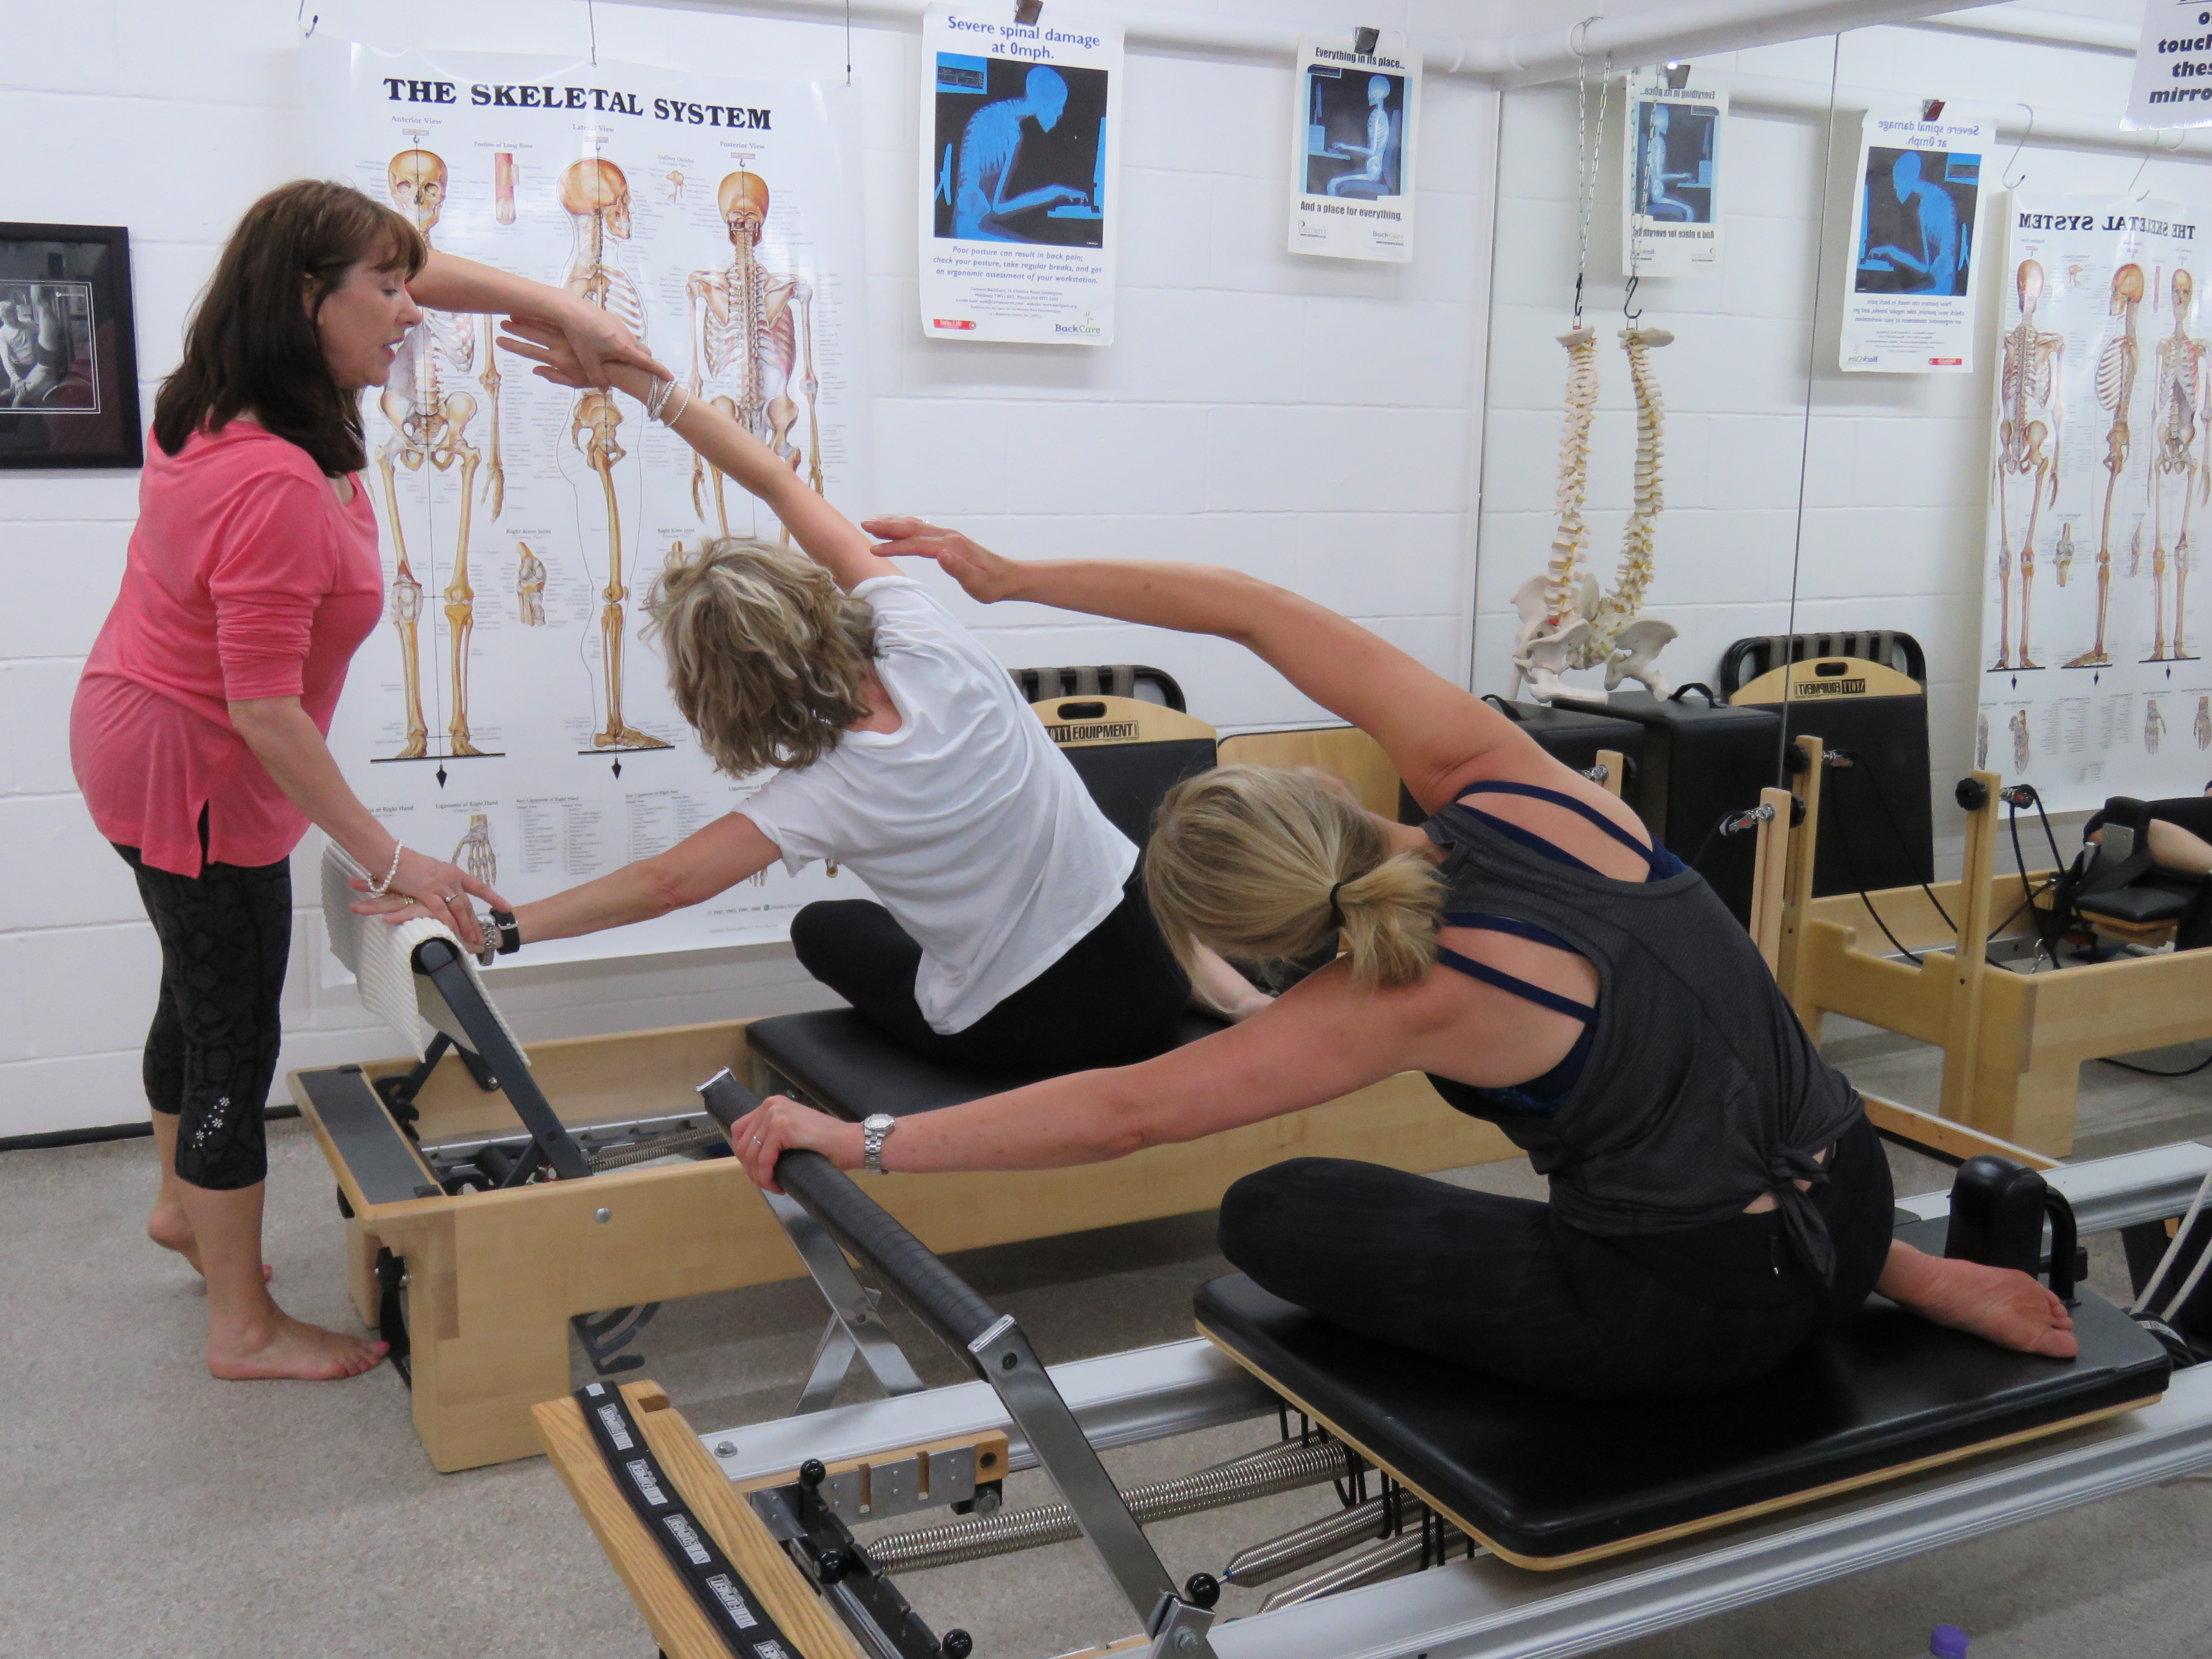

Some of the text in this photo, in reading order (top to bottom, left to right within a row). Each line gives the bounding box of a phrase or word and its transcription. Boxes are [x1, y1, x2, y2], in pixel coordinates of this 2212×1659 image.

[948, 16, 1100, 49] Severe spinal damage
[992, 42, 1054, 61] at 0mph.
[1315, 47, 1356, 63] Everything
[1358, 54, 1365, 63] in
[1367, 55, 1377, 65] its
[383, 78, 772, 130] THE SKELETAL SYSTEM
[391, 116, 422, 124] Anterior
[573, 123, 596, 132] Lateral
[720, 141, 747, 149] Posterior
[1300, 201, 1315, 212] And
[1323, 204, 1345, 215] place
[1346, 205, 1358, 216] for
[1359, 208, 1403, 222] everything.
[1372, 230, 1405, 239] BackCare
[952, 246, 969, 254] Poor
[971, 247, 998, 258] posture
[1015, 250, 1035, 258] result
[1046, 252, 1063, 260] back
[1065, 253, 1083, 263] pain;
[933, 256, 1102, 275] check your posture, take regular breaks, and get
[947, 269, 984, 279] ergonomic
[986, 271, 1025, 280] assessment
[1027, 272, 1036, 282] of
[1036, 274, 1053, 282] your
[1055, 275, 1098, 284] workstation.
[1055, 323, 1101, 334] BackCare
[1072, 723, 1133, 740] EQUIPMENT
